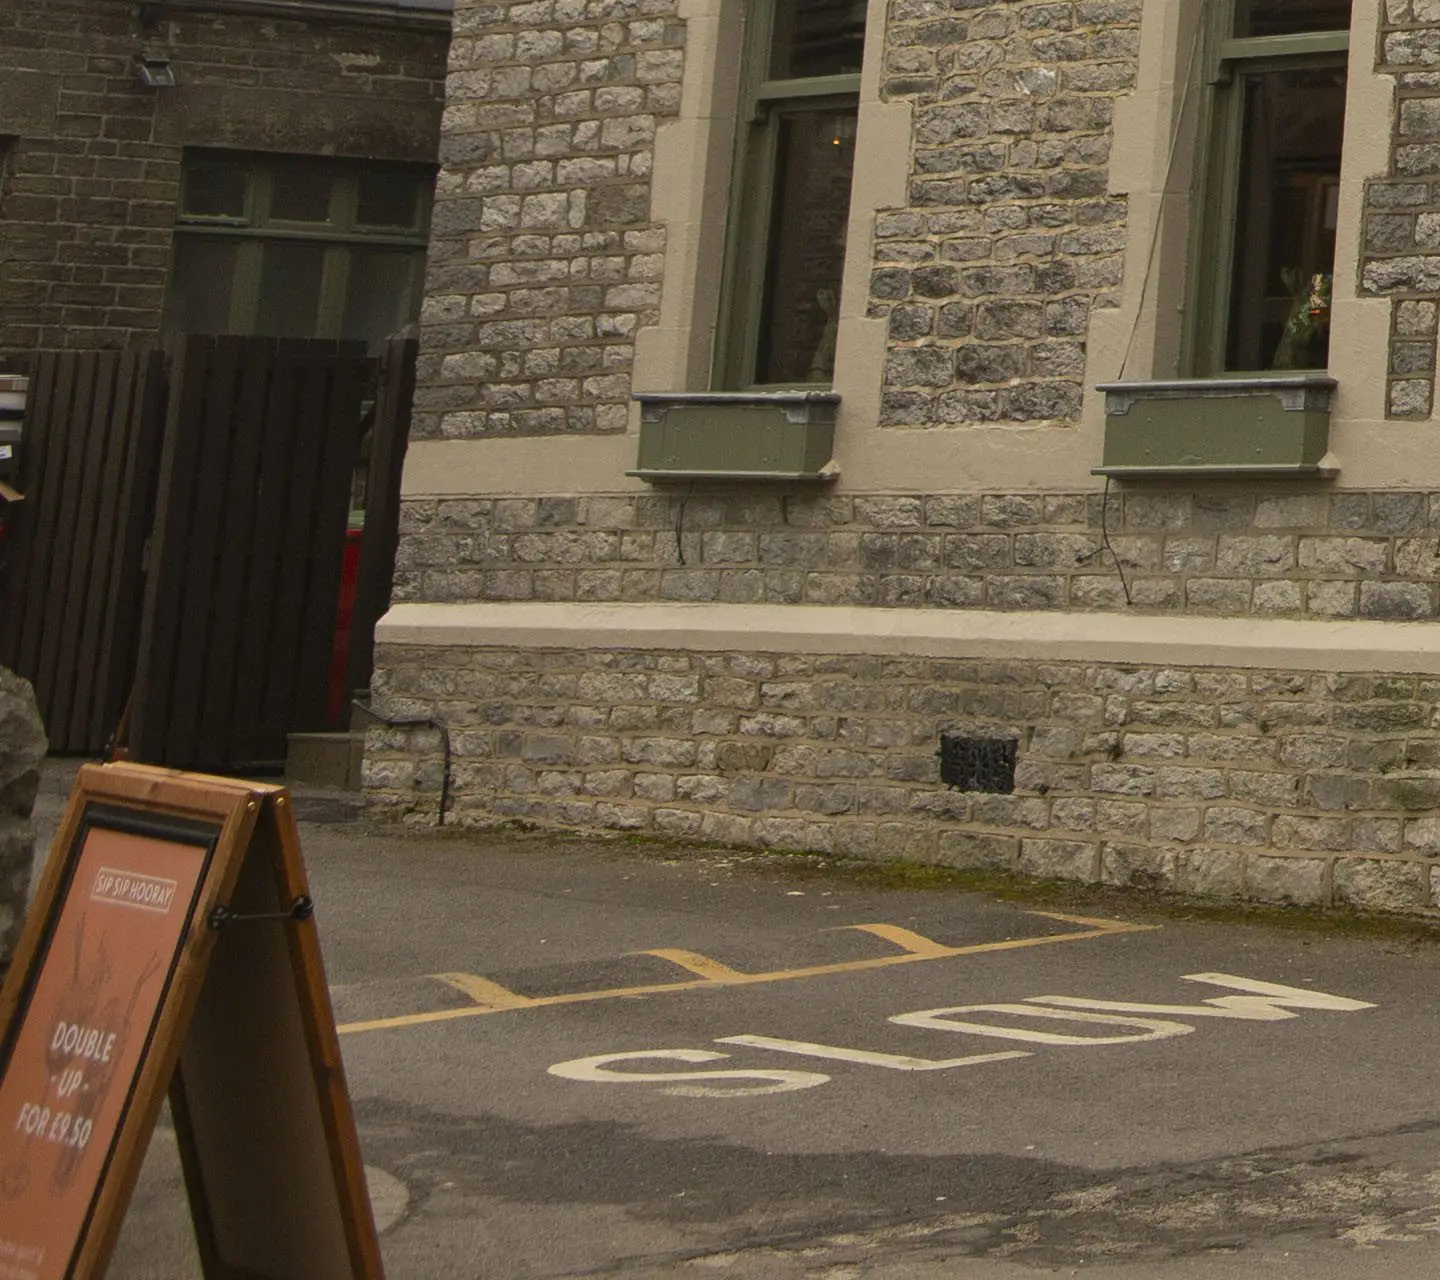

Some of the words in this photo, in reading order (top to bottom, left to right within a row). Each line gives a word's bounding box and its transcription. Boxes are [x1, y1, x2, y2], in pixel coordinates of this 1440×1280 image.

[95, 874, 114, 894] SIP
[112, 877, 131, 898] SIP
[128, 880, 173, 905] HOORAY
[52, 1020, 117, 1063] DOUBLE
[545, 971, 1378, 1099] SLOW
[15, 1102, 51, 1137] FOR
